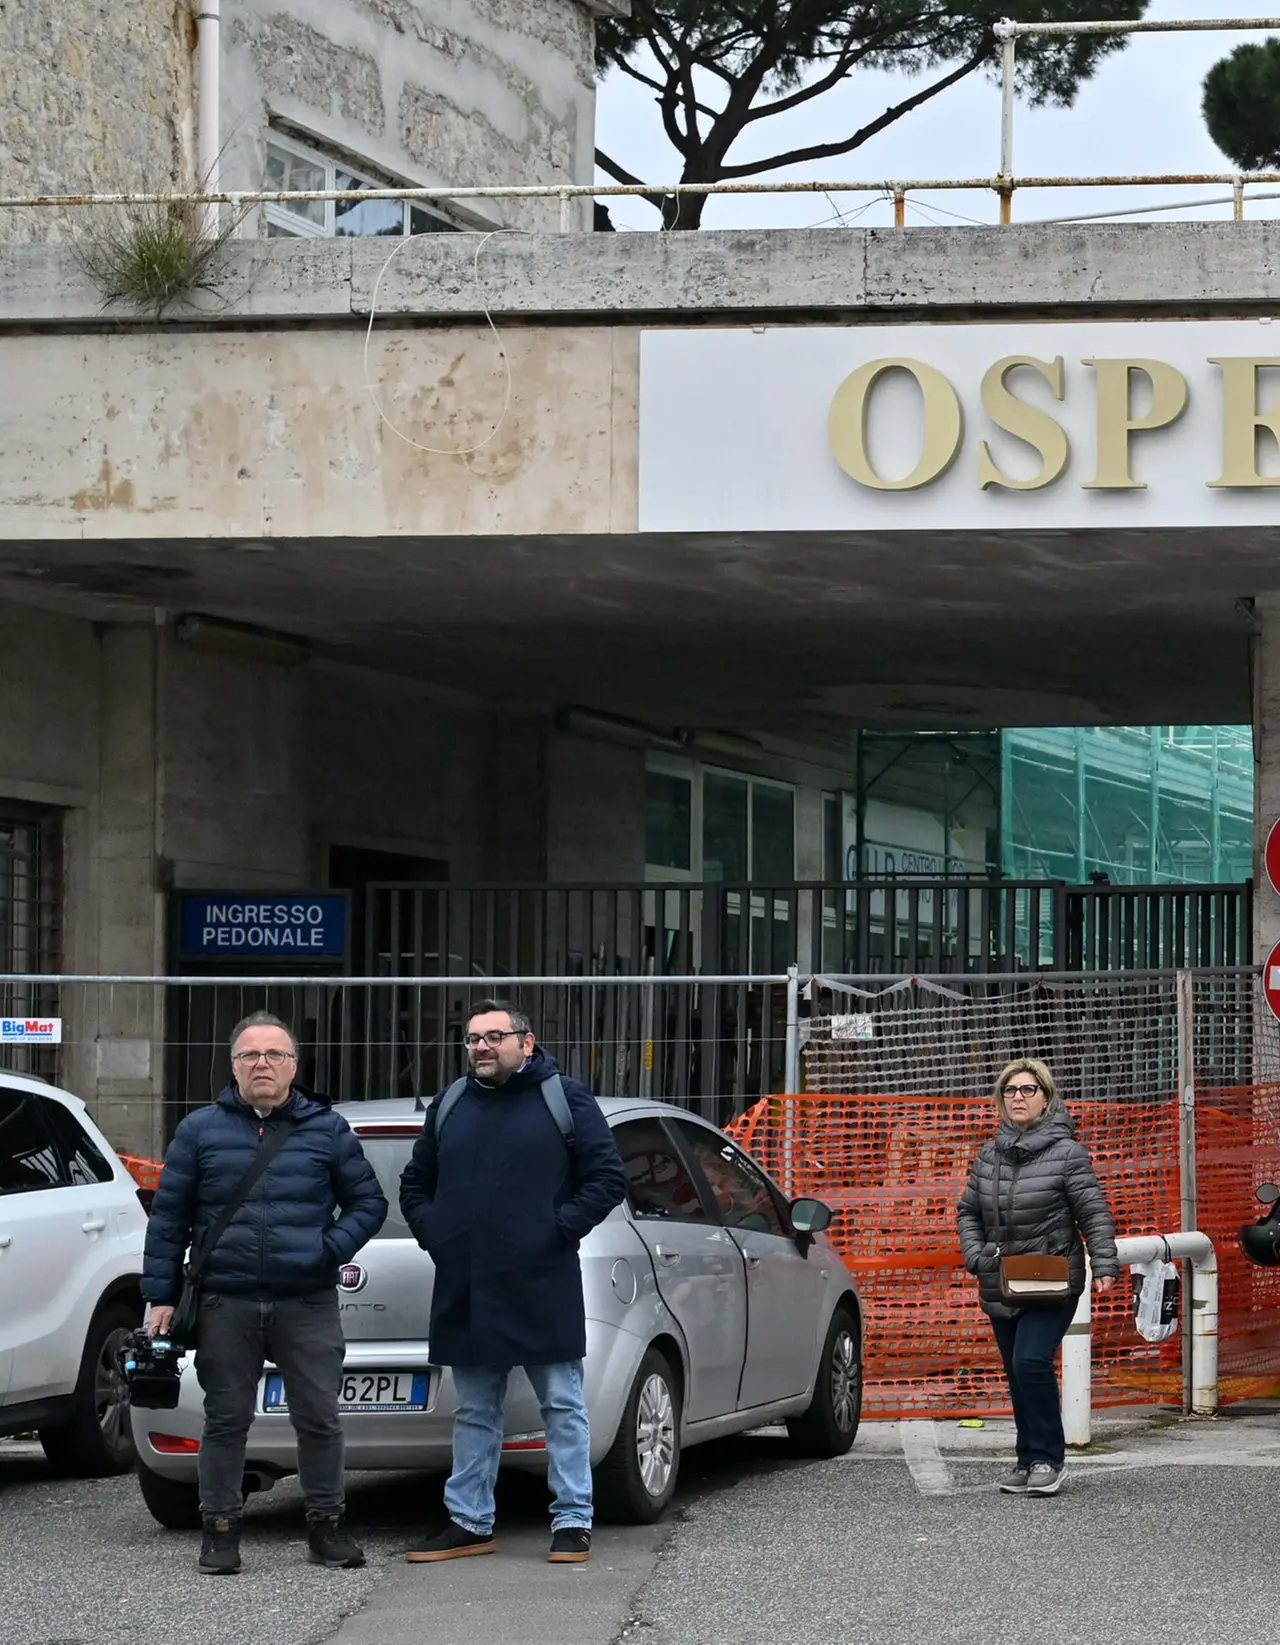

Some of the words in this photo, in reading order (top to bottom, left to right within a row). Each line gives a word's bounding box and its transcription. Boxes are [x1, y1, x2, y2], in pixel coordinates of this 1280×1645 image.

[206, 904, 323, 924] INGRESSO
[203, 927, 324, 946] PEDONALE
[2, 1020, 54, 1035] BigMat
[342, 1376, 407, 1402] 62PL
